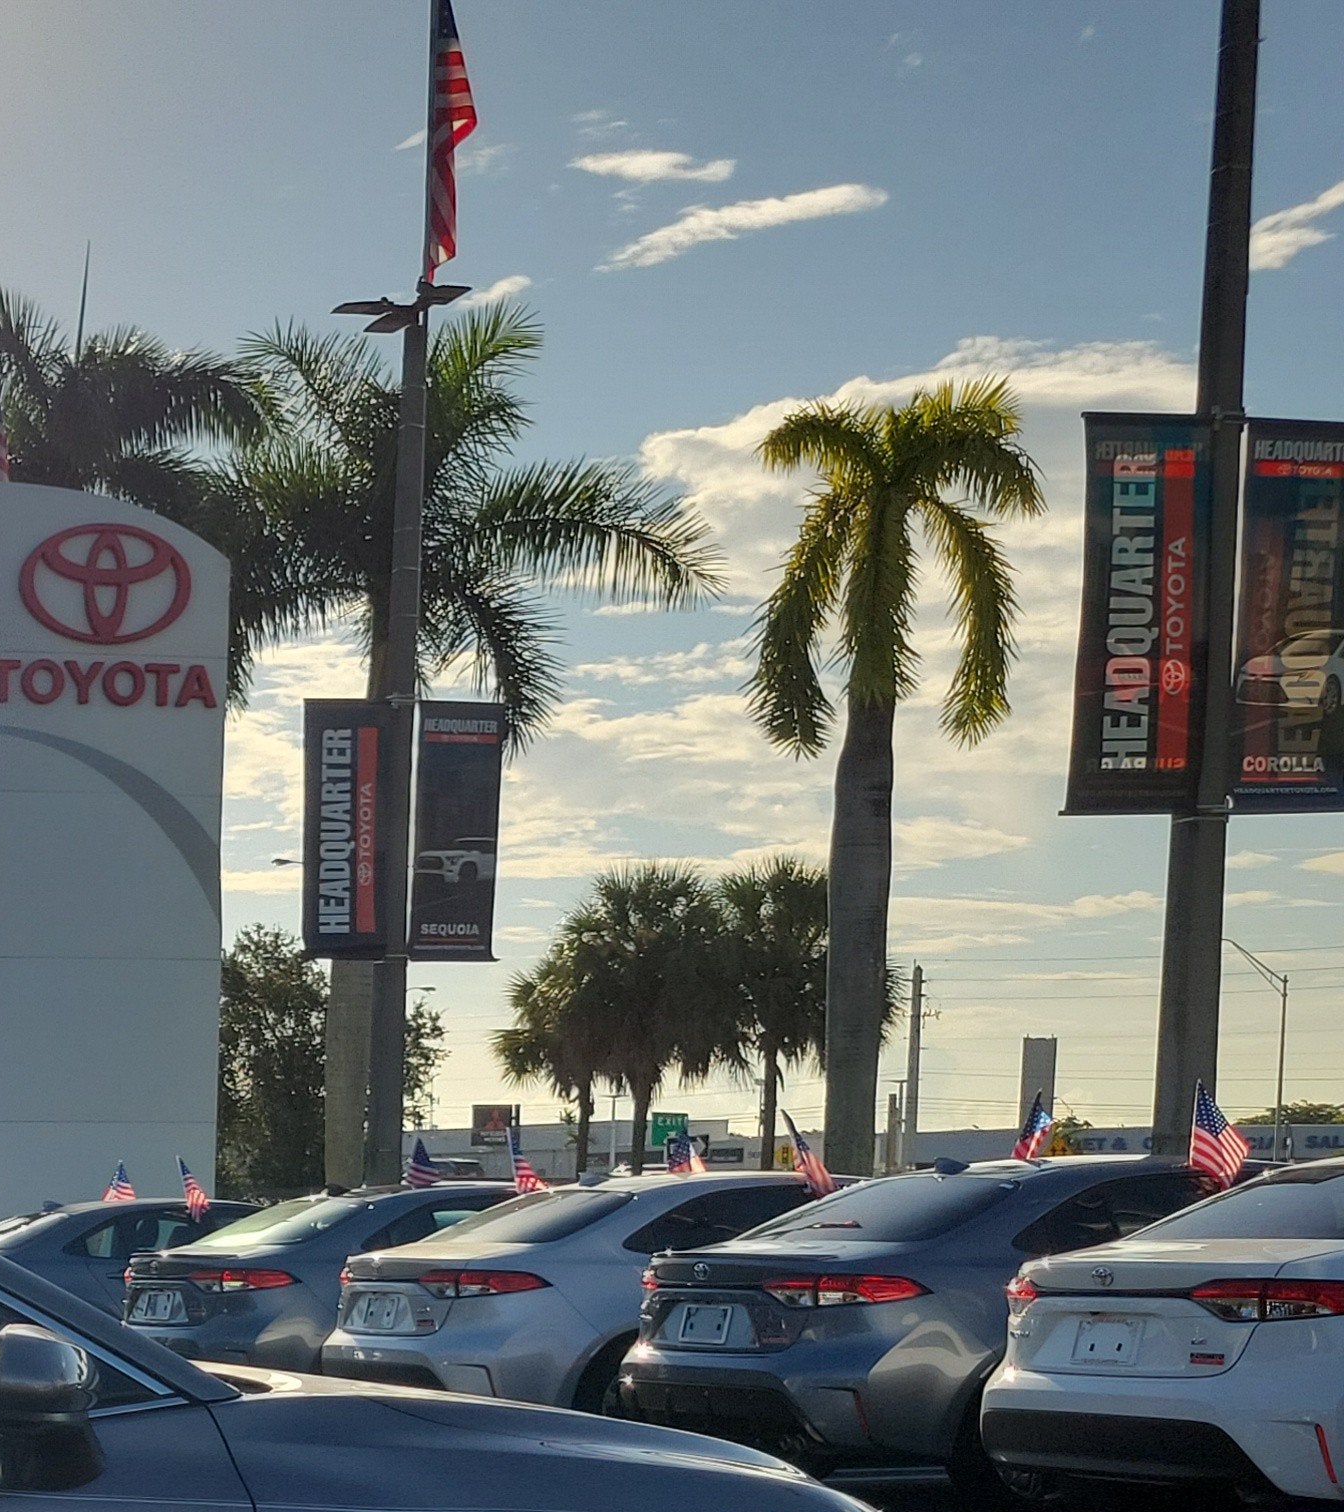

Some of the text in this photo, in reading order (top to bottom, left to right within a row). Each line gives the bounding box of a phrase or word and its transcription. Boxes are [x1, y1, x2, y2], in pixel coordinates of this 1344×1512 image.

[1254, 440, 1344, 463] HEADQUART
[1166, 537, 1186, 656] TOYOTA
[1100, 453, 1158, 770] HEADQUARTER
[424, 718, 498, 734] HEADQUARTER
[1243, 755, 1325, 772] COROLLA
[318, 728, 355, 934] HEADQUARTER
[360, 782, 372, 858] TOYOTA
[420, 923, 480, 937] SEQUOIA
[657, 1116, 683, 1126] EXIT
